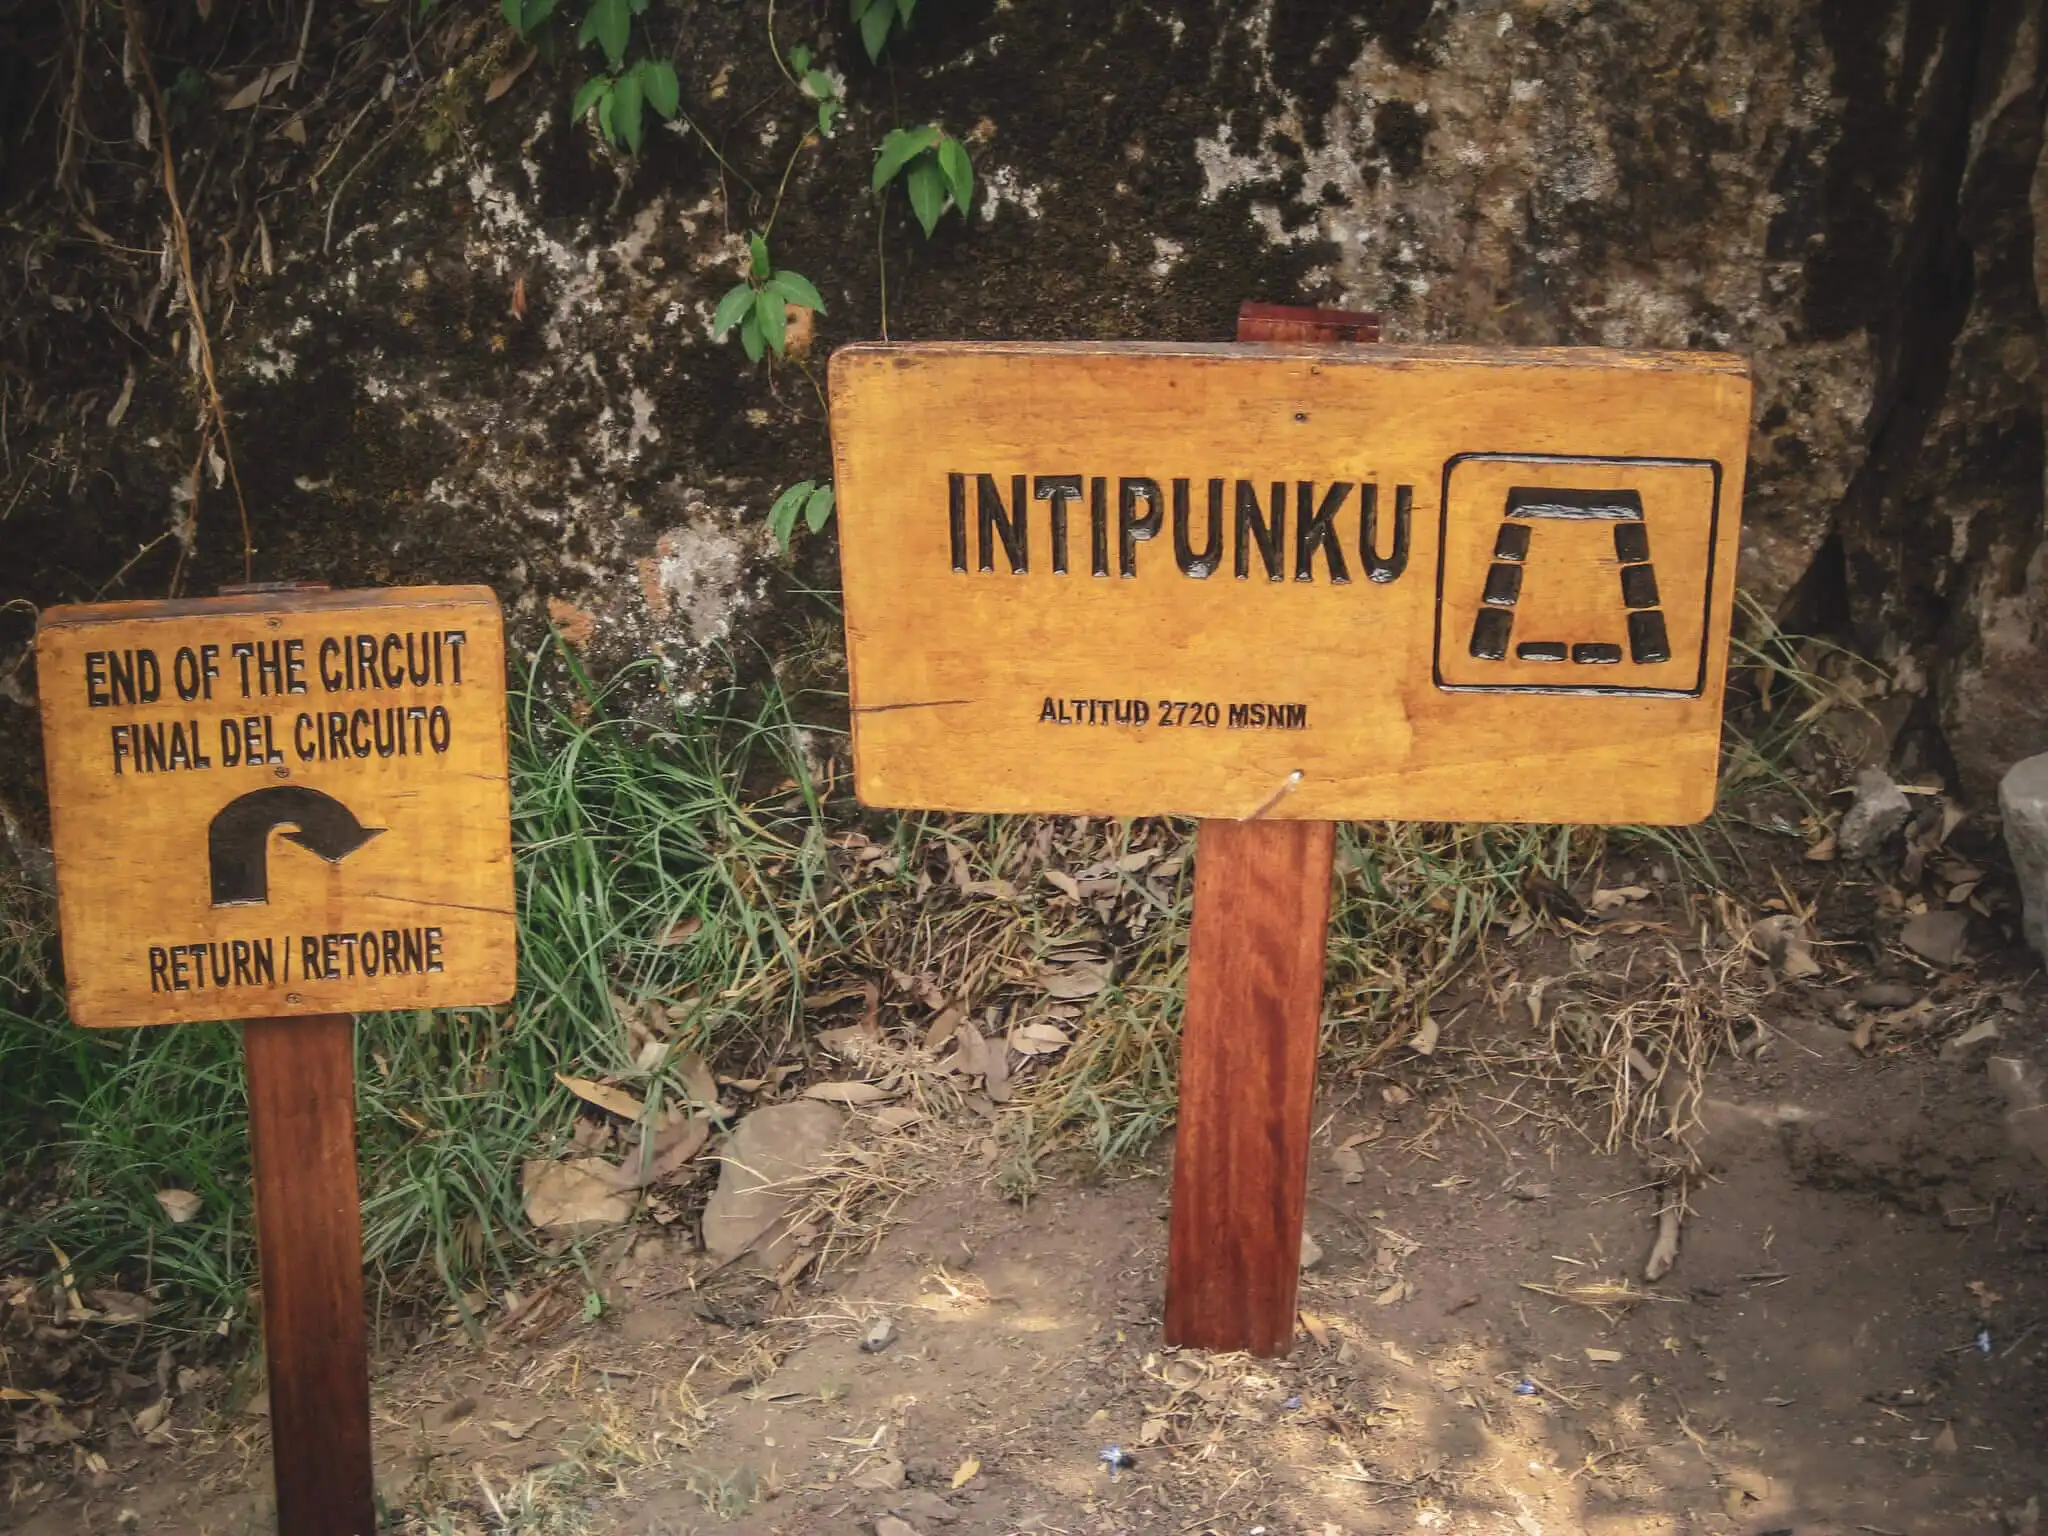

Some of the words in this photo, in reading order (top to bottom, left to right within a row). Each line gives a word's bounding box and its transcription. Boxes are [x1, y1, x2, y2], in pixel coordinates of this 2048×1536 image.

[948, 472, 1414, 585] INTIPUNKU
[85, 649, 160, 707] END
[174, 644, 219, 701] OF
[232, 639, 307, 698] THE
[319, 630, 466, 693] CIRCUIT
[111, 720, 210, 775] FINAL
[221, 715, 284, 767] DEL
[294, 705, 451, 761] CIRCUITO
[1039, 697, 1149, 726] ALTITUD
[1158, 700, 1220, 727] 2720
[1228, 703, 1307, 729] MSNM
[149, 937, 275, 993] RETURN
[302, 927, 444, 980] RETORNE
